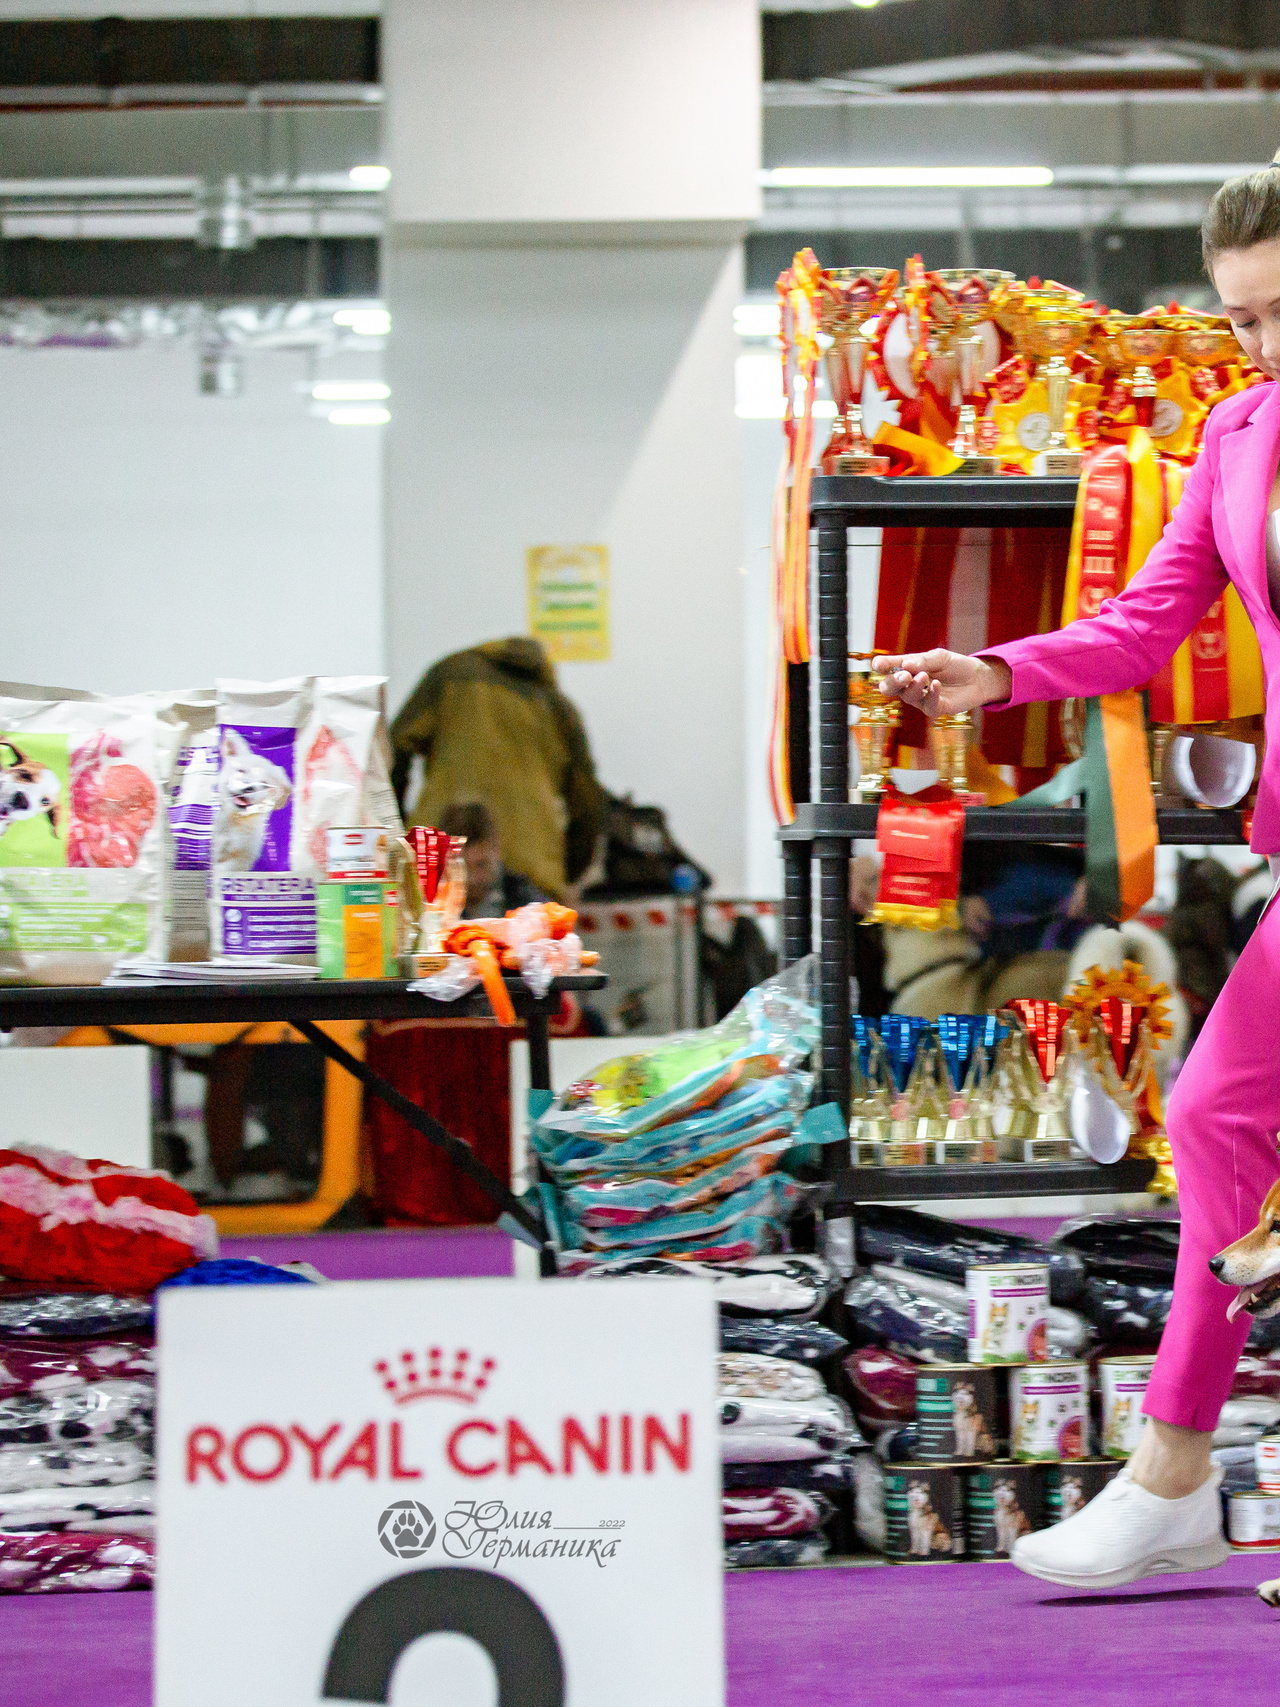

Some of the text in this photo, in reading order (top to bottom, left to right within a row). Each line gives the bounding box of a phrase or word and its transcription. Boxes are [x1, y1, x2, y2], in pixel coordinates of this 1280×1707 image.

[1082, 556, 1116, 574] III
[184, 1411, 693, 1485] ROYAL CANIN
